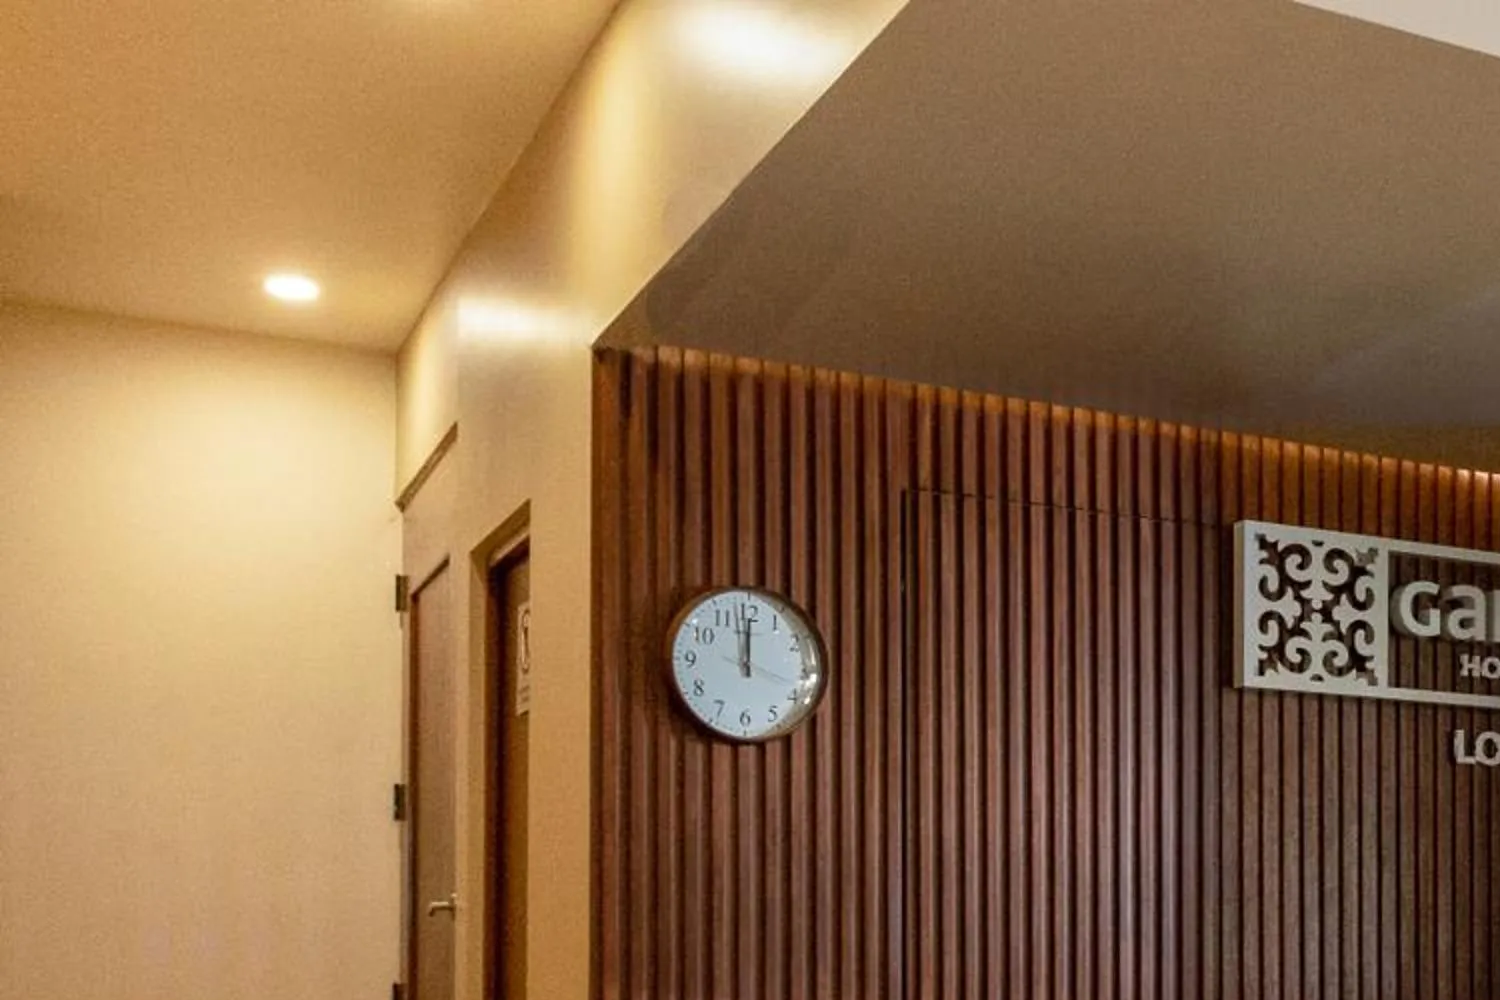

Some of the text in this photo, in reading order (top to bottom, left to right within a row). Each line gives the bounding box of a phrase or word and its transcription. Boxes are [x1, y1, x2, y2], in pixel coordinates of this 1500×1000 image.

[715, 609, 730, 627] 11
[741, 603, 759, 622] 12
[772, 615, 778, 632] 1
[695, 626, 715, 645] 10
[685, 650, 697, 668] 9
[693, 679, 704, 697] 8
[787, 688, 798, 704] 4
[713, 700, 725, 717] 7
[740, 708, 751, 727] 6
[767, 705, 778, 723] 5
